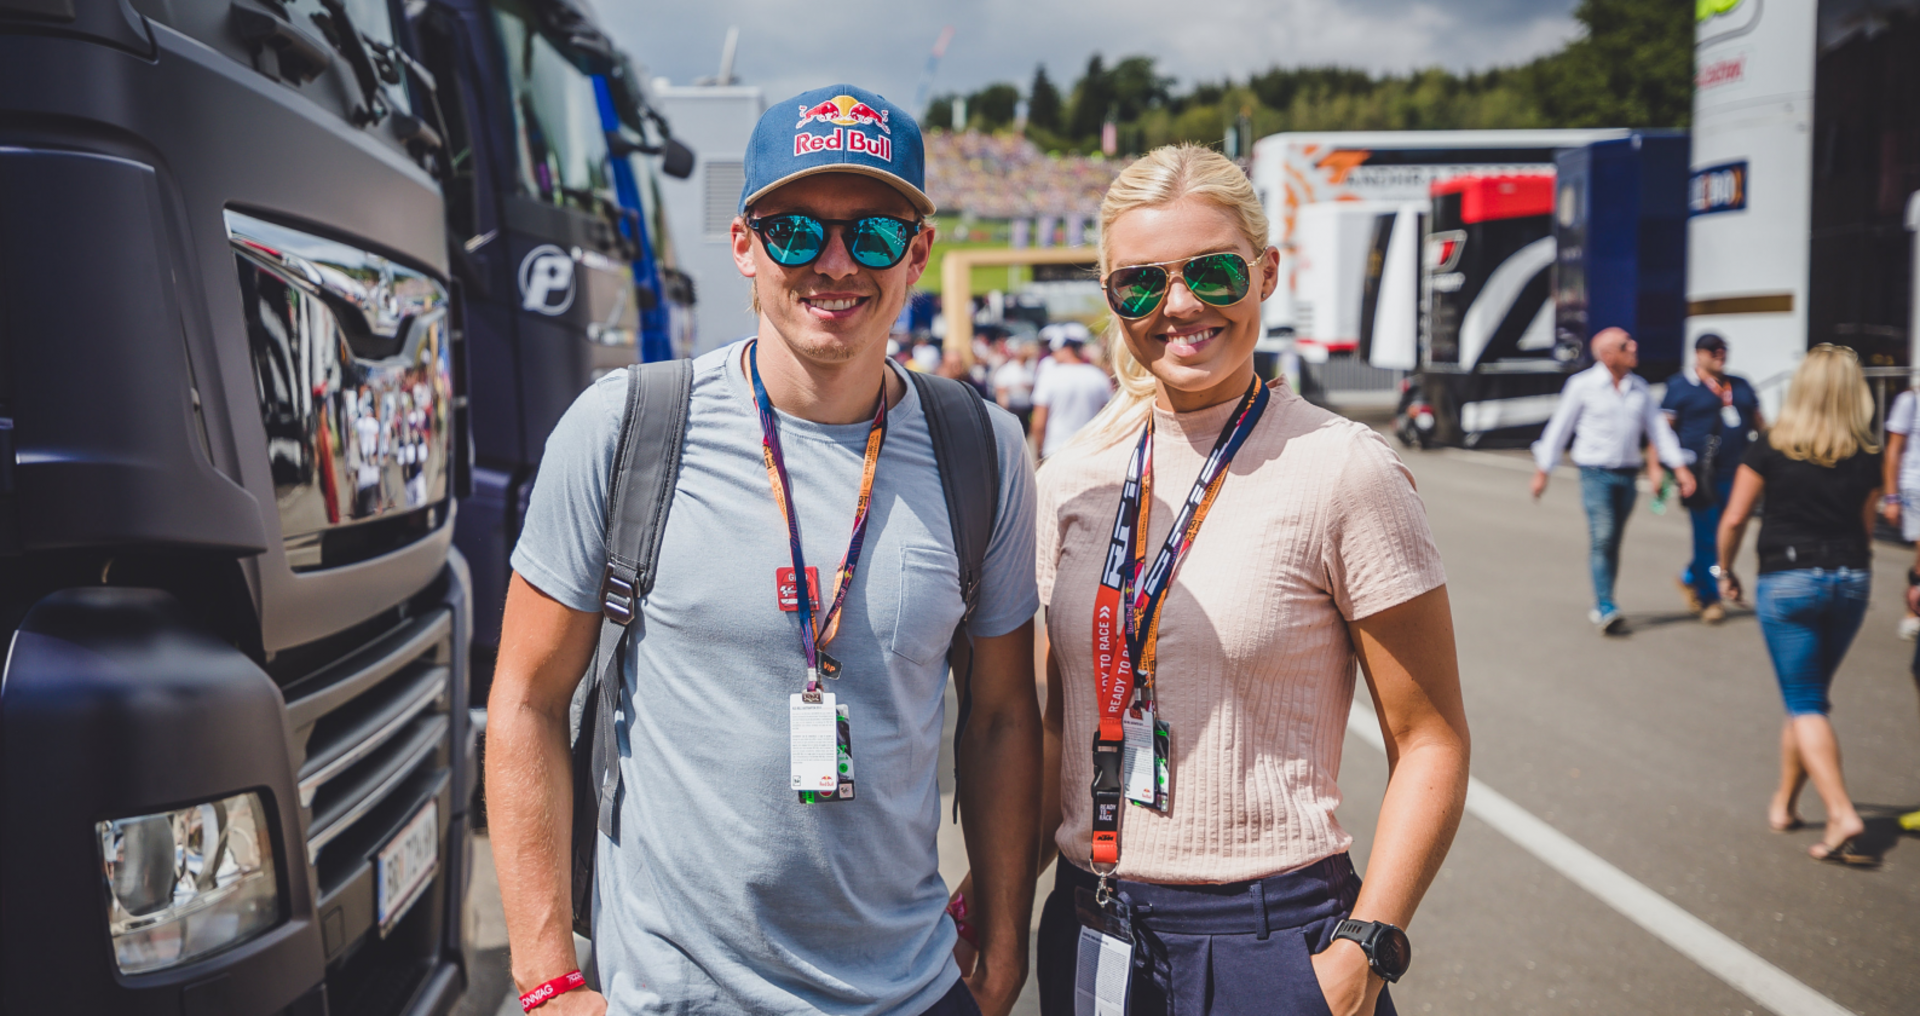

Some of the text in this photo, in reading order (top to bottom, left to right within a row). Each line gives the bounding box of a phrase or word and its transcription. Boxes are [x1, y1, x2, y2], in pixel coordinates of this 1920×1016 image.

[795, 128, 892, 162] Red Bull
[1099, 622, 1110, 650] RACE
[823, 662, 836, 673] VIP
[1100, 654, 1111, 668] TO
[1108, 678, 1127, 713] READY
[1118, 661, 1131, 674] TO
